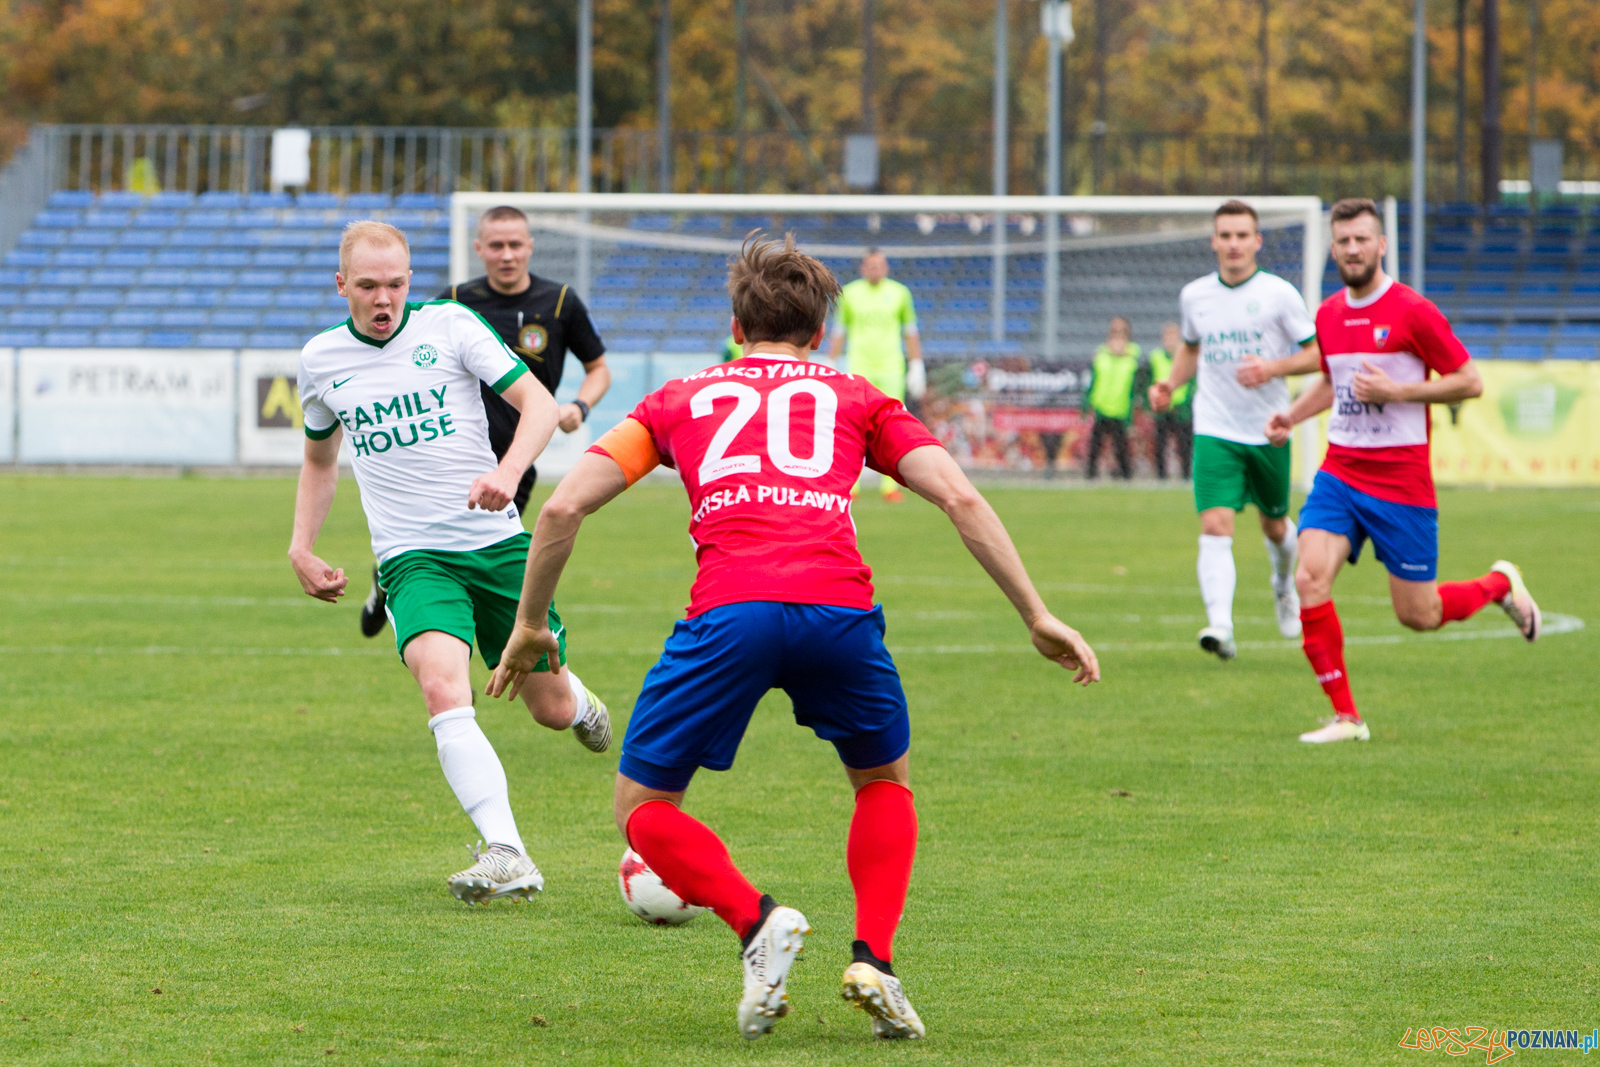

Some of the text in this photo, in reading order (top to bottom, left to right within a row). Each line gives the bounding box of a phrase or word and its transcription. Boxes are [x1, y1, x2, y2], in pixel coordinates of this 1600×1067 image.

[338, 384, 447, 431] FAMILY
[352, 413, 456, 457] HOUSE
[690, 378, 838, 486] 20
[757, 485, 848, 514] PUŁAWY
